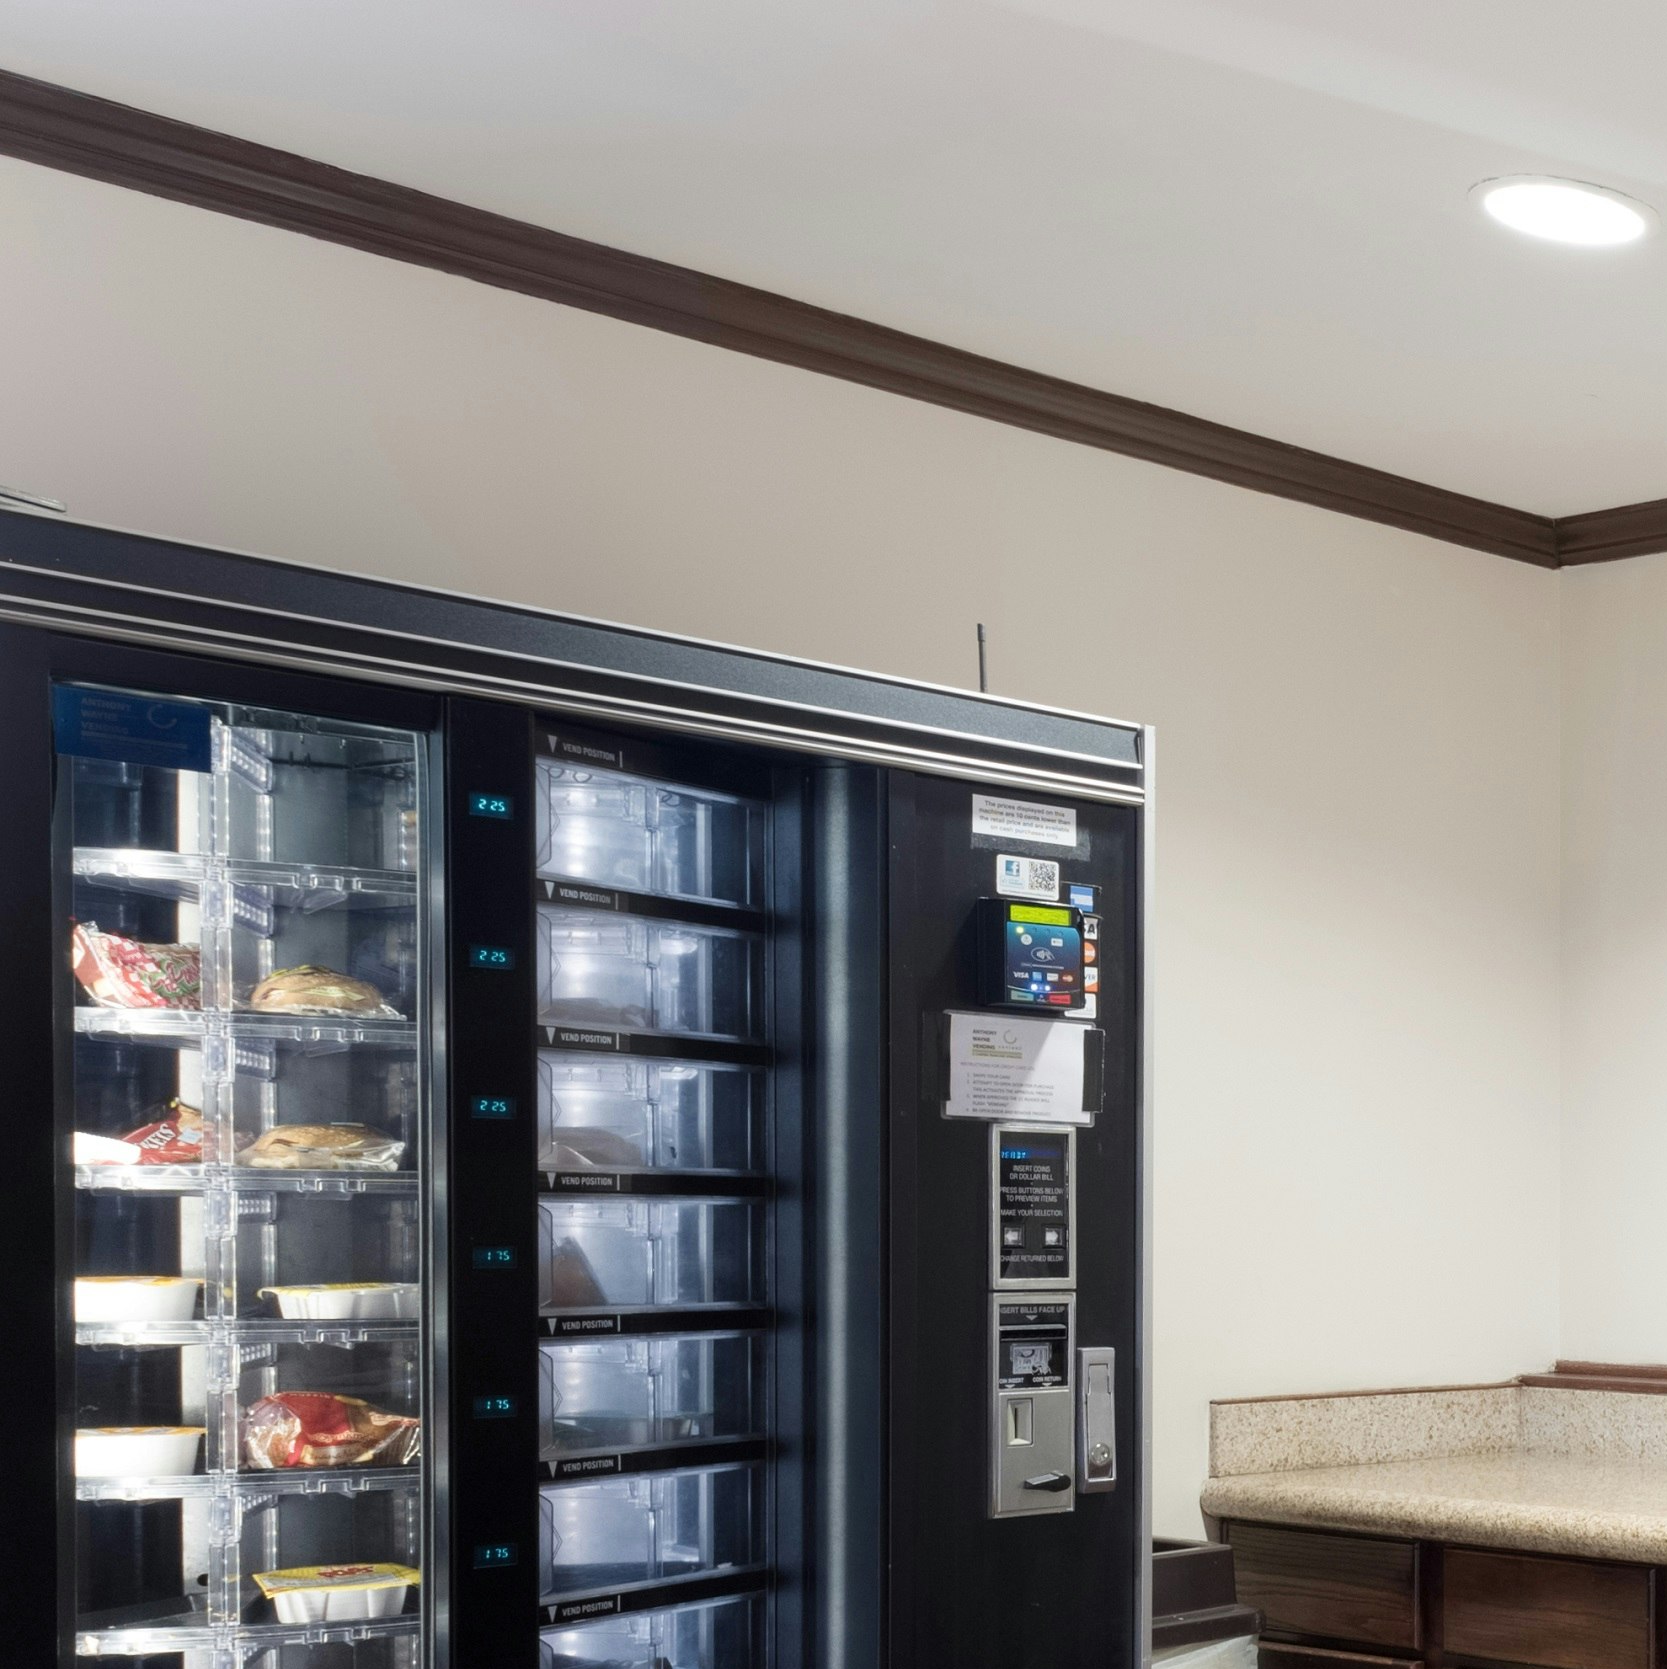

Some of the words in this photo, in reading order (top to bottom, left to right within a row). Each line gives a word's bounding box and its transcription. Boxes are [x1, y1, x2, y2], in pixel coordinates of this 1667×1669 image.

[563, 743, 582, 754] VEND
[583, 747, 616, 761] POSITION
[560, 887, 579, 898] VEND
[580, 890, 611, 904] POSITION
[1013, 971, 1030, 979] VISA
[561, 1033, 580, 1042] VEND
[581, 1034, 612, 1044] POSITION
[561, 1176, 580, 1185] VEND
[581, 1176, 613, 1186] POSITION
[1000, 1306, 1019, 1314] NSERT
[562, 1321, 581, 1330] VEND
[582, 1319, 613, 1329] POSITION
[562, 1463, 582, 1472] VEND
[583, 1459, 614, 1471] POSITION
[562, 1607, 581, 1616] VEND
[582, 1600, 614, 1614] POSITION
